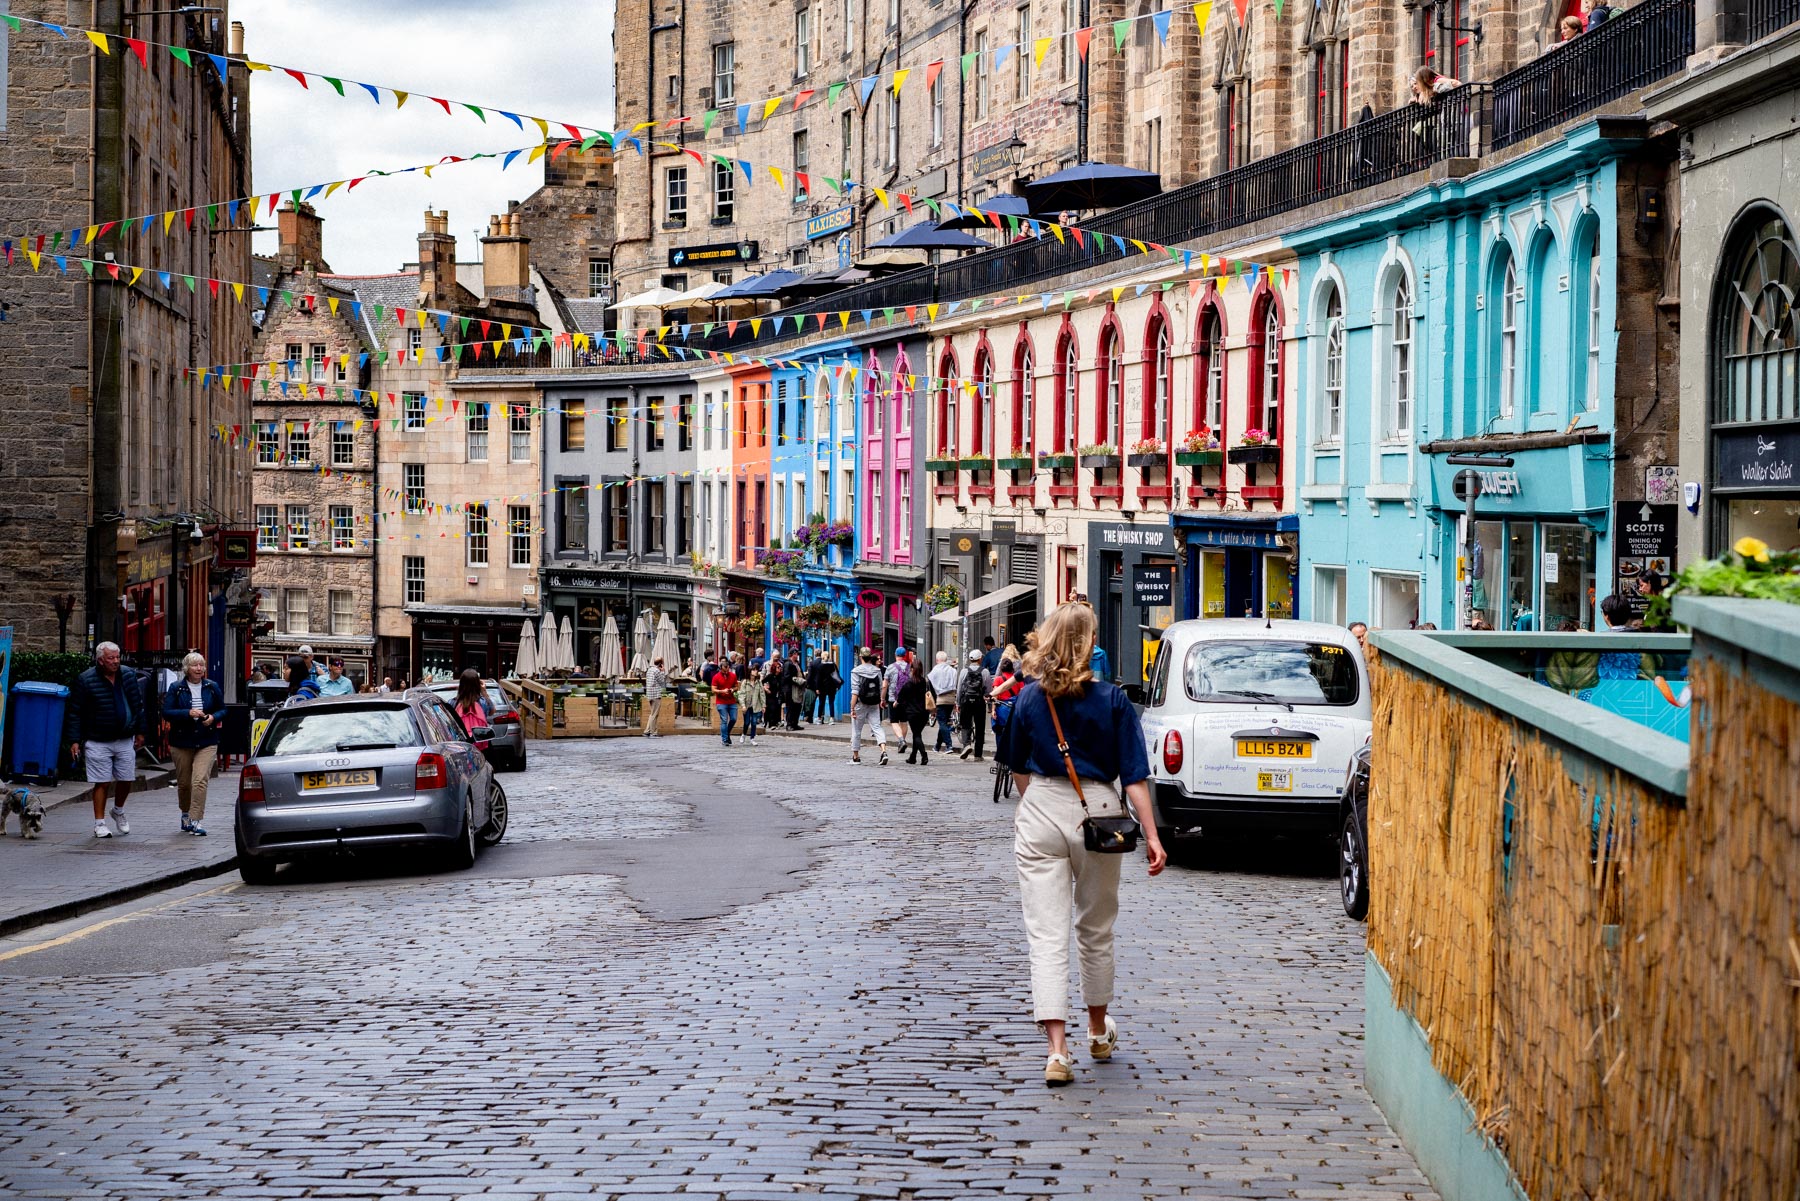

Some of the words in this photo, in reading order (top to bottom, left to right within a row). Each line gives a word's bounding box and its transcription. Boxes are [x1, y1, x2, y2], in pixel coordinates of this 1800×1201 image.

[1741, 461, 1769, 481] Walker
[1770, 460, 1793, 480] Slater
[1626, 524, 1665, 532] SCOTTS
[1103, 529, 1116, 543] THE
[1117, 528, 1143, 545] WHISKY
[1145, 531, 1164, 546] SHOP
[572, 577, 596, 587] Walker
[600, 579, 621, 588] Slater
[1135, 582, 1170, 591] WHISKY
[1321, 646, 1344, 655] P371
[1245, 743, 1275, 755] LL15
[1278, 743, 1304, 756] BZW
[1204, 764, 1225, 773] Draught
[1225, 765, 1247, 773] Proofing
[1301, 767, 1327, 775] Secondary
[344, 772, 370, 784] ZES
[1274, 774, 1287, 782] 741
[1316, 783, 1334, 791] Cutting
